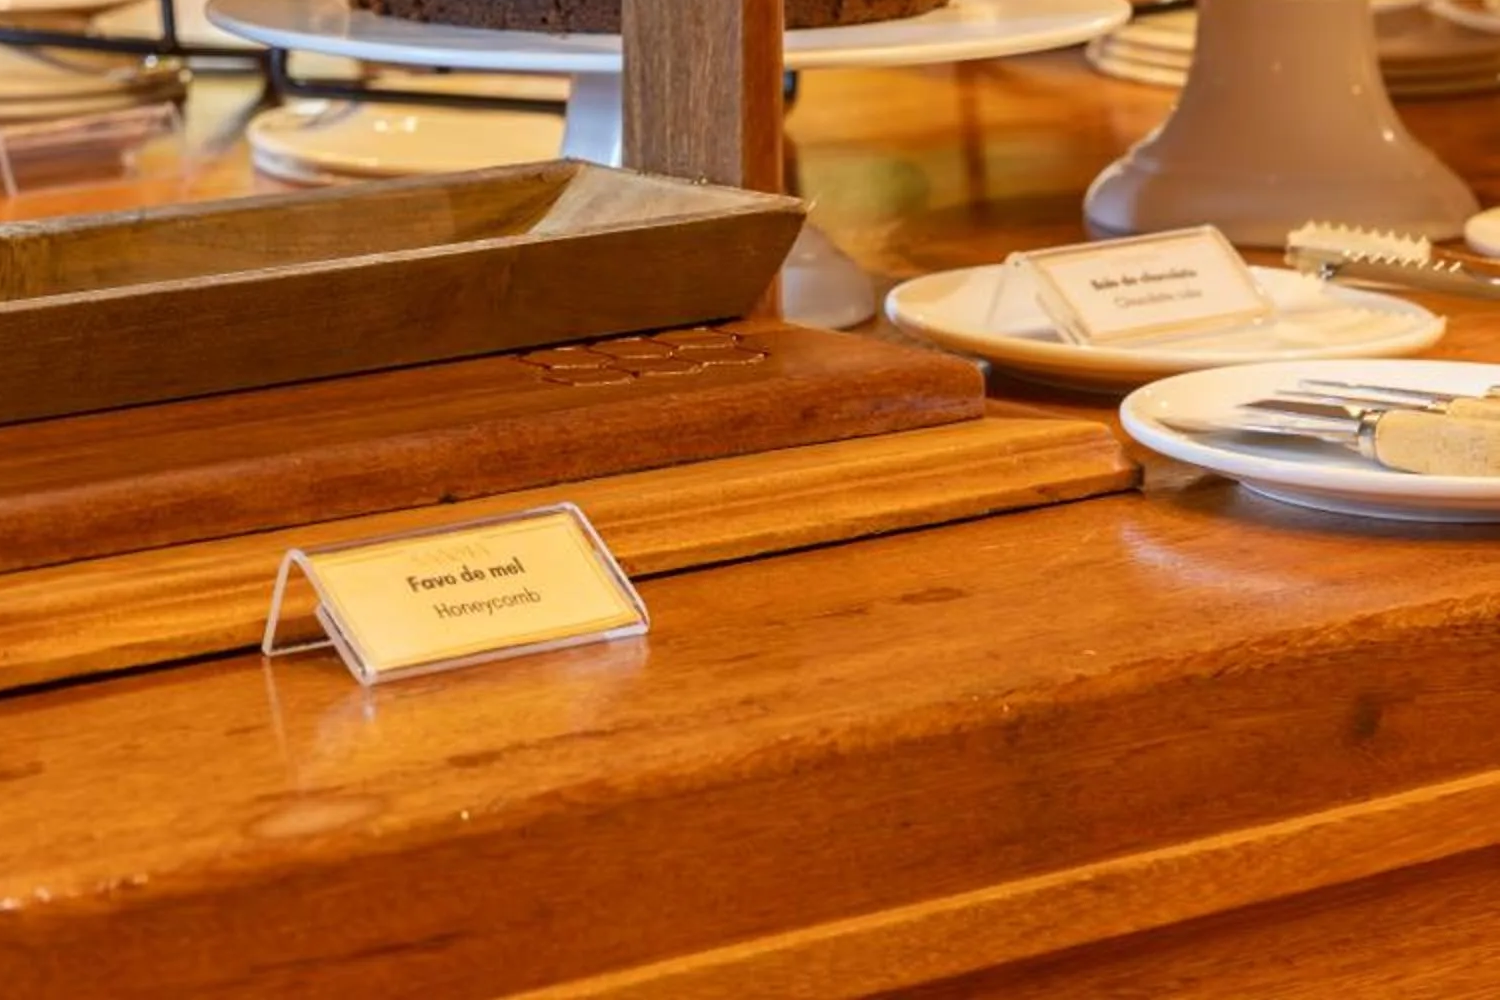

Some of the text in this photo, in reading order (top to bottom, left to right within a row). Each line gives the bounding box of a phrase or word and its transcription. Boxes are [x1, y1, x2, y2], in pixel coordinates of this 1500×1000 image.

[406, 556, 526, 593] Favo de mel
[433, 586, 542, 619] Honeycomb
